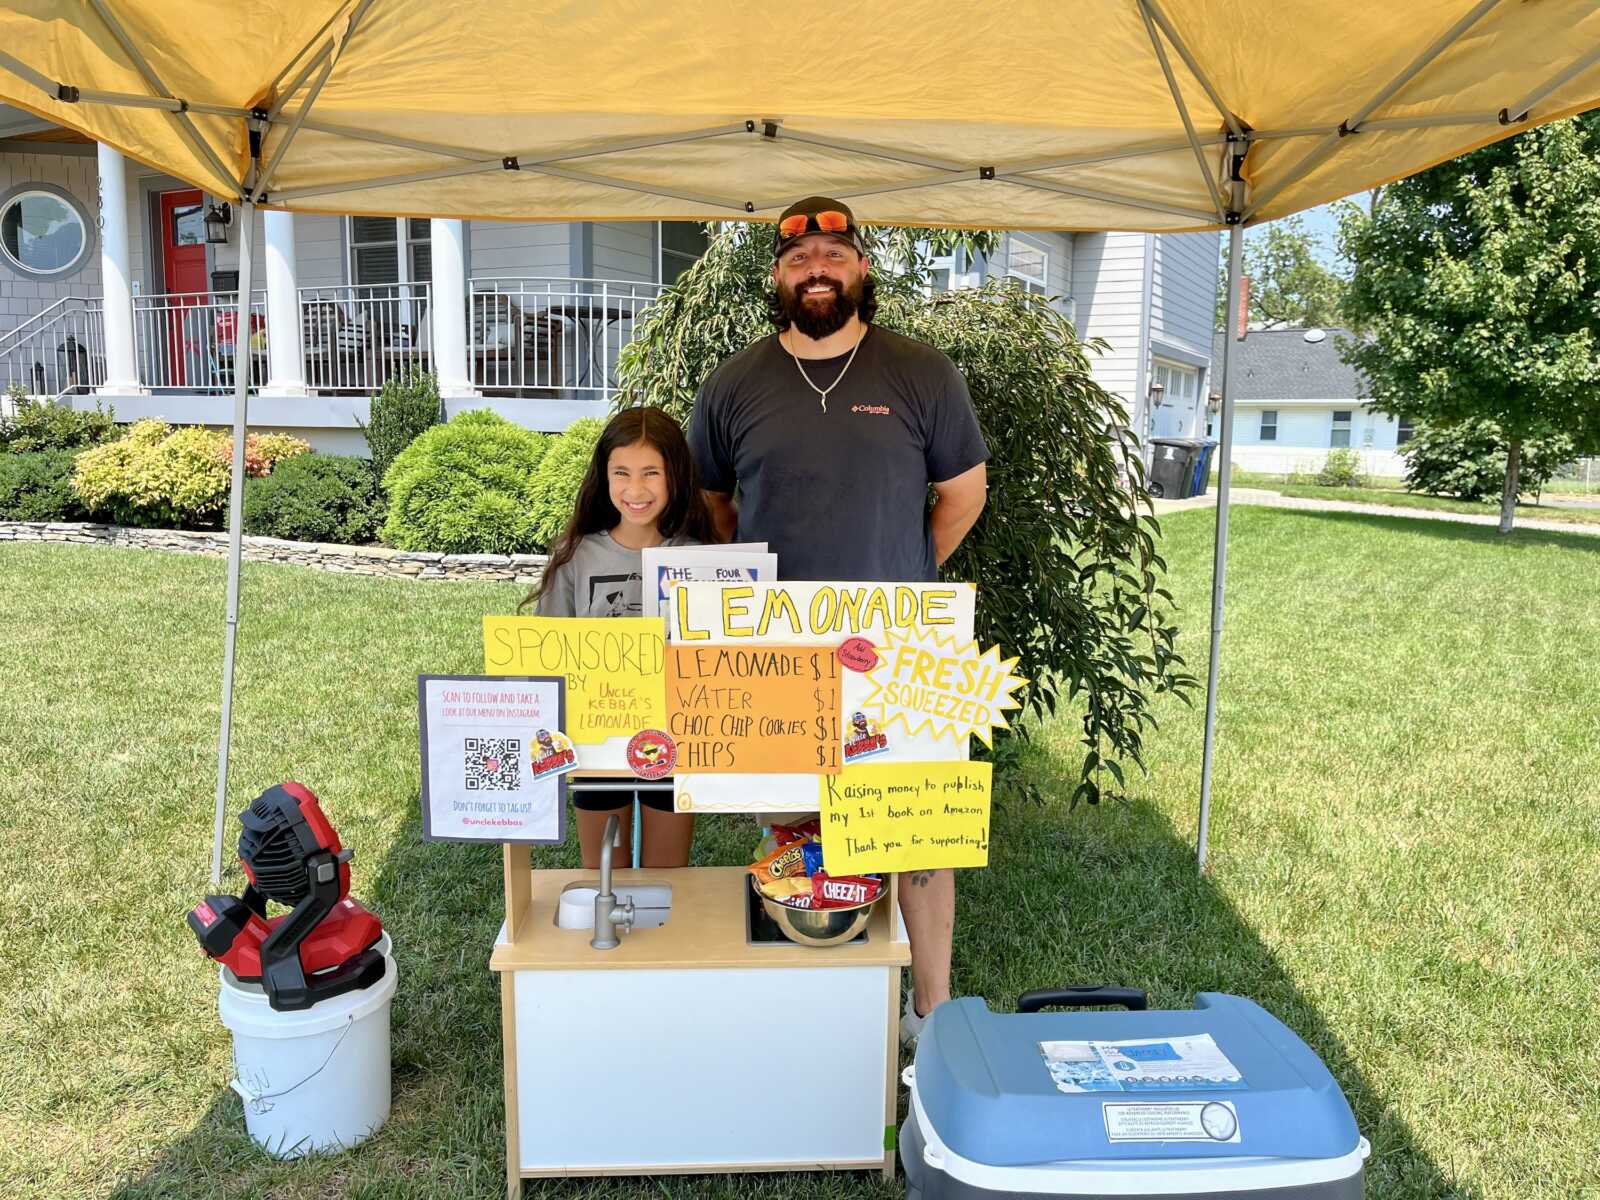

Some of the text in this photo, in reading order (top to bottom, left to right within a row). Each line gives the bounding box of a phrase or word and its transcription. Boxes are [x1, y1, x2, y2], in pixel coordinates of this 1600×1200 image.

[665, 568, 741, 580] THE FOUR
[676, 585, 957, 641] LEMONADE
[489, 628, 665, 676] SPONSORED
[676, 648, 804, 679] LEMONADE
[566, 672, 588, 692] BY
[892, 645, 1005, 702] FRESH
[442, 691, 461, 703] SCAN
[464, 691, 472, 703] TO
[472, 691, 498, 704] FOLLOW
[500, 692, 515, 704] AND
[517, 692, 533, 704] TAKE
[588, 697, 653, 710] KEBBA'S
[676, 684, 753, 710] WATER
[883, 681, 991, 726] SQUEEZED
[506, 708, 540, 719] INSTAGRAM
[580, 714, 653, 730] LEMONADE
[720, 714, 753, 738] CHIP
[759, 716, 807, 738] COOKIES
[675, 741, 735, 767] CHIPS
[826, 773, 985, 806] Raising money to publish
[453, 800, 474, 812] DON'T
[475, 801, 496, 812] FORGET
[497, 801, 506, 812] TO
[507, 802, 518, 813] TAG
[830, 812, 849, 827] my
[888, 805, 914, 818] book
[920, 808, 933, 816] on
[943, 803, 983, 815] Amazon
[462, 817, 523, 826] @unclekebbas
[845, 827, 988, 857] Thank you for supporting!
[769, 848, 802, 878] Cheetos
